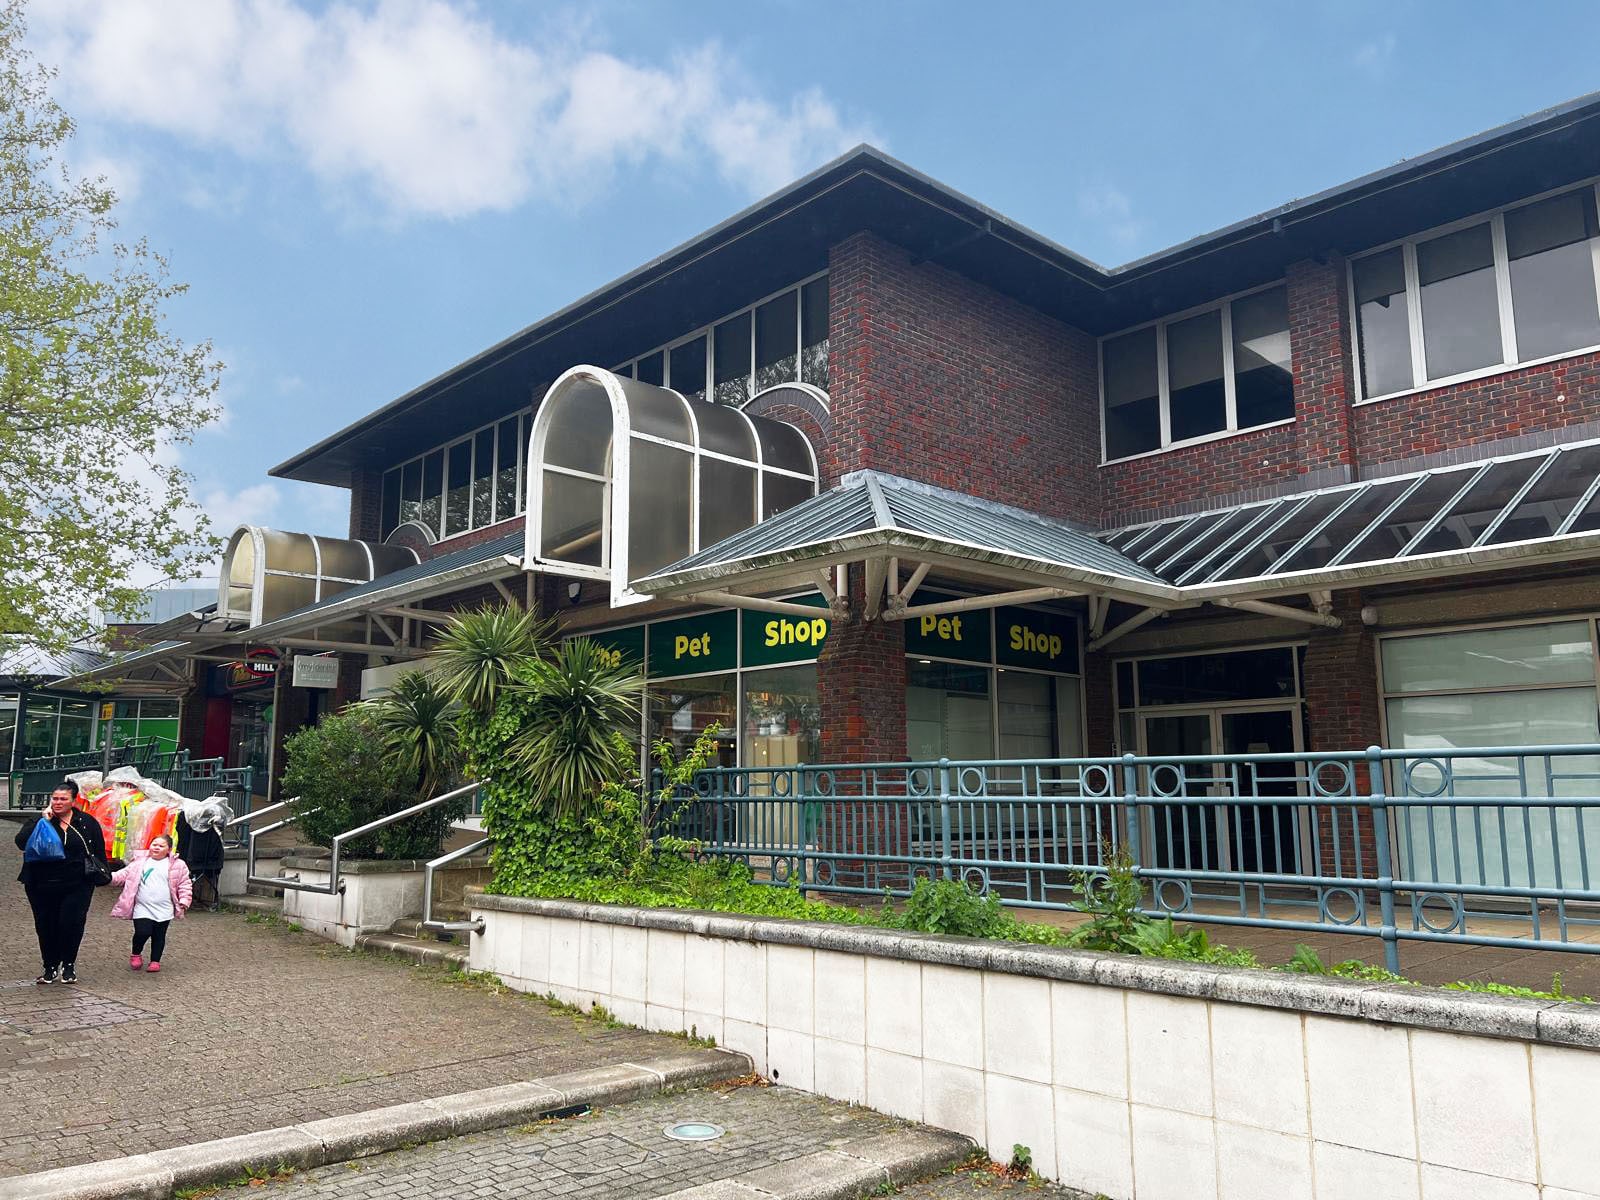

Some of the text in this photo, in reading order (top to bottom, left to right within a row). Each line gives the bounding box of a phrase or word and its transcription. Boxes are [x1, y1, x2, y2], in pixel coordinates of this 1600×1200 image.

[675, 632, 711, 660] Pet
[765, 618, 827, 647] Shop
[920, 613, 1062, 660] Pet Shop
[253, 663, 275, 672] HILL
